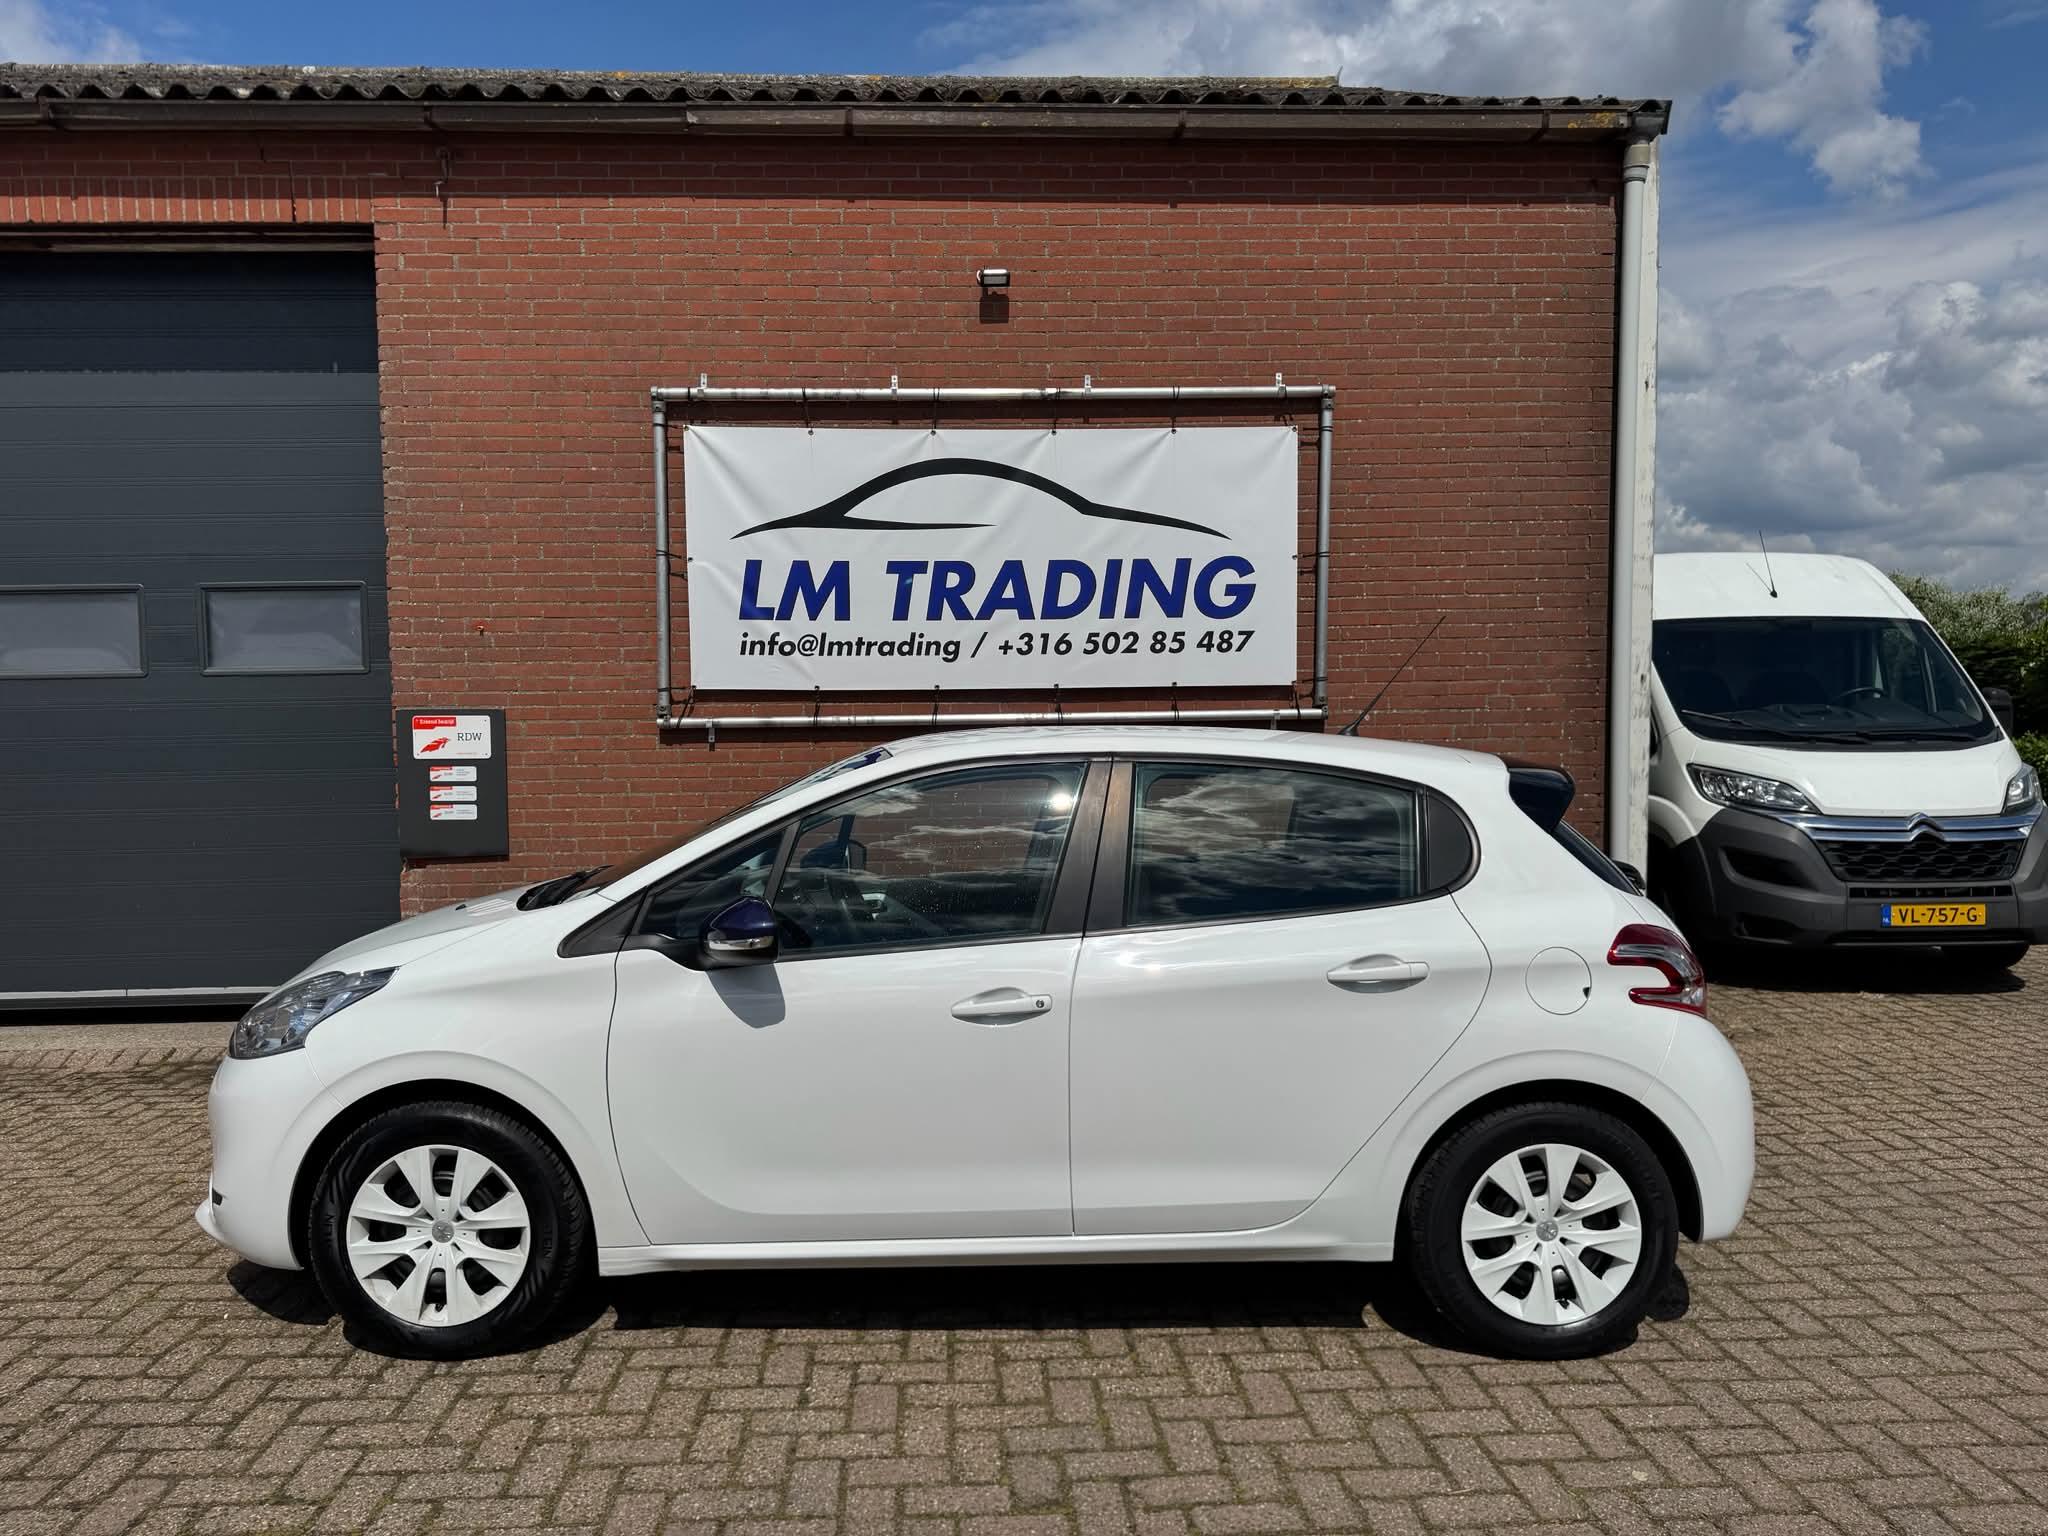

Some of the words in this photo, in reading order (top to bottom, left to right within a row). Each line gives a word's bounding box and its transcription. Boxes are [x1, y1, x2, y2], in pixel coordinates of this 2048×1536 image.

[739, 560, 850, 621] LM
[886, 556, 1257, 621] TRADING
[740, 632, 961, 663] info@lmtrading
[970, 632, 989, 658] /
[998, 632, 1073, 656] +316
[1083, 631, 1140, 655] 502
[1150, 631, 1186, 654] 85
[1196, 630, 1256, 653] 487
[457, 732, 482, 742] RDW
[1898, 907, 1978, 924] VL-757-G
